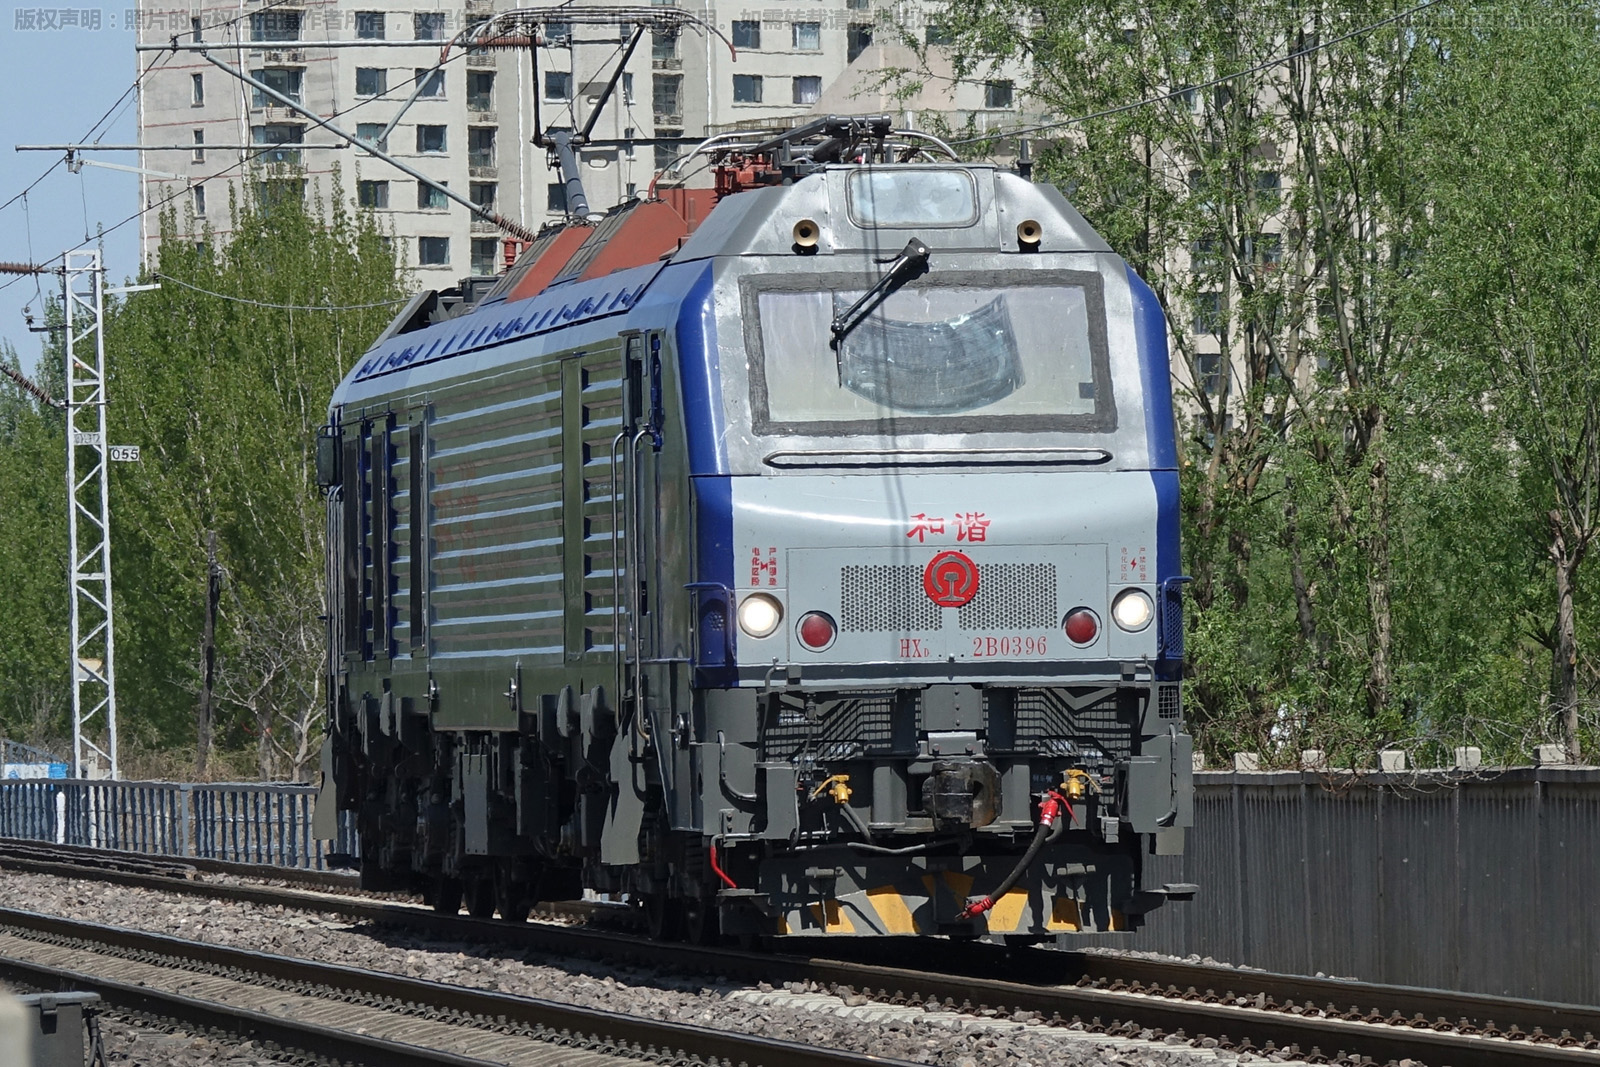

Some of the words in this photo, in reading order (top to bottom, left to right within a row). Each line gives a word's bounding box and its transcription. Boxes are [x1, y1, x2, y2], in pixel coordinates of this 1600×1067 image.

[112, 449, 139, 460] 055
[906, 512, 991, 543] 和谐
[751, 547, 760, 586] 电化区段
[973, 636, 1047, 657] 2B0396
